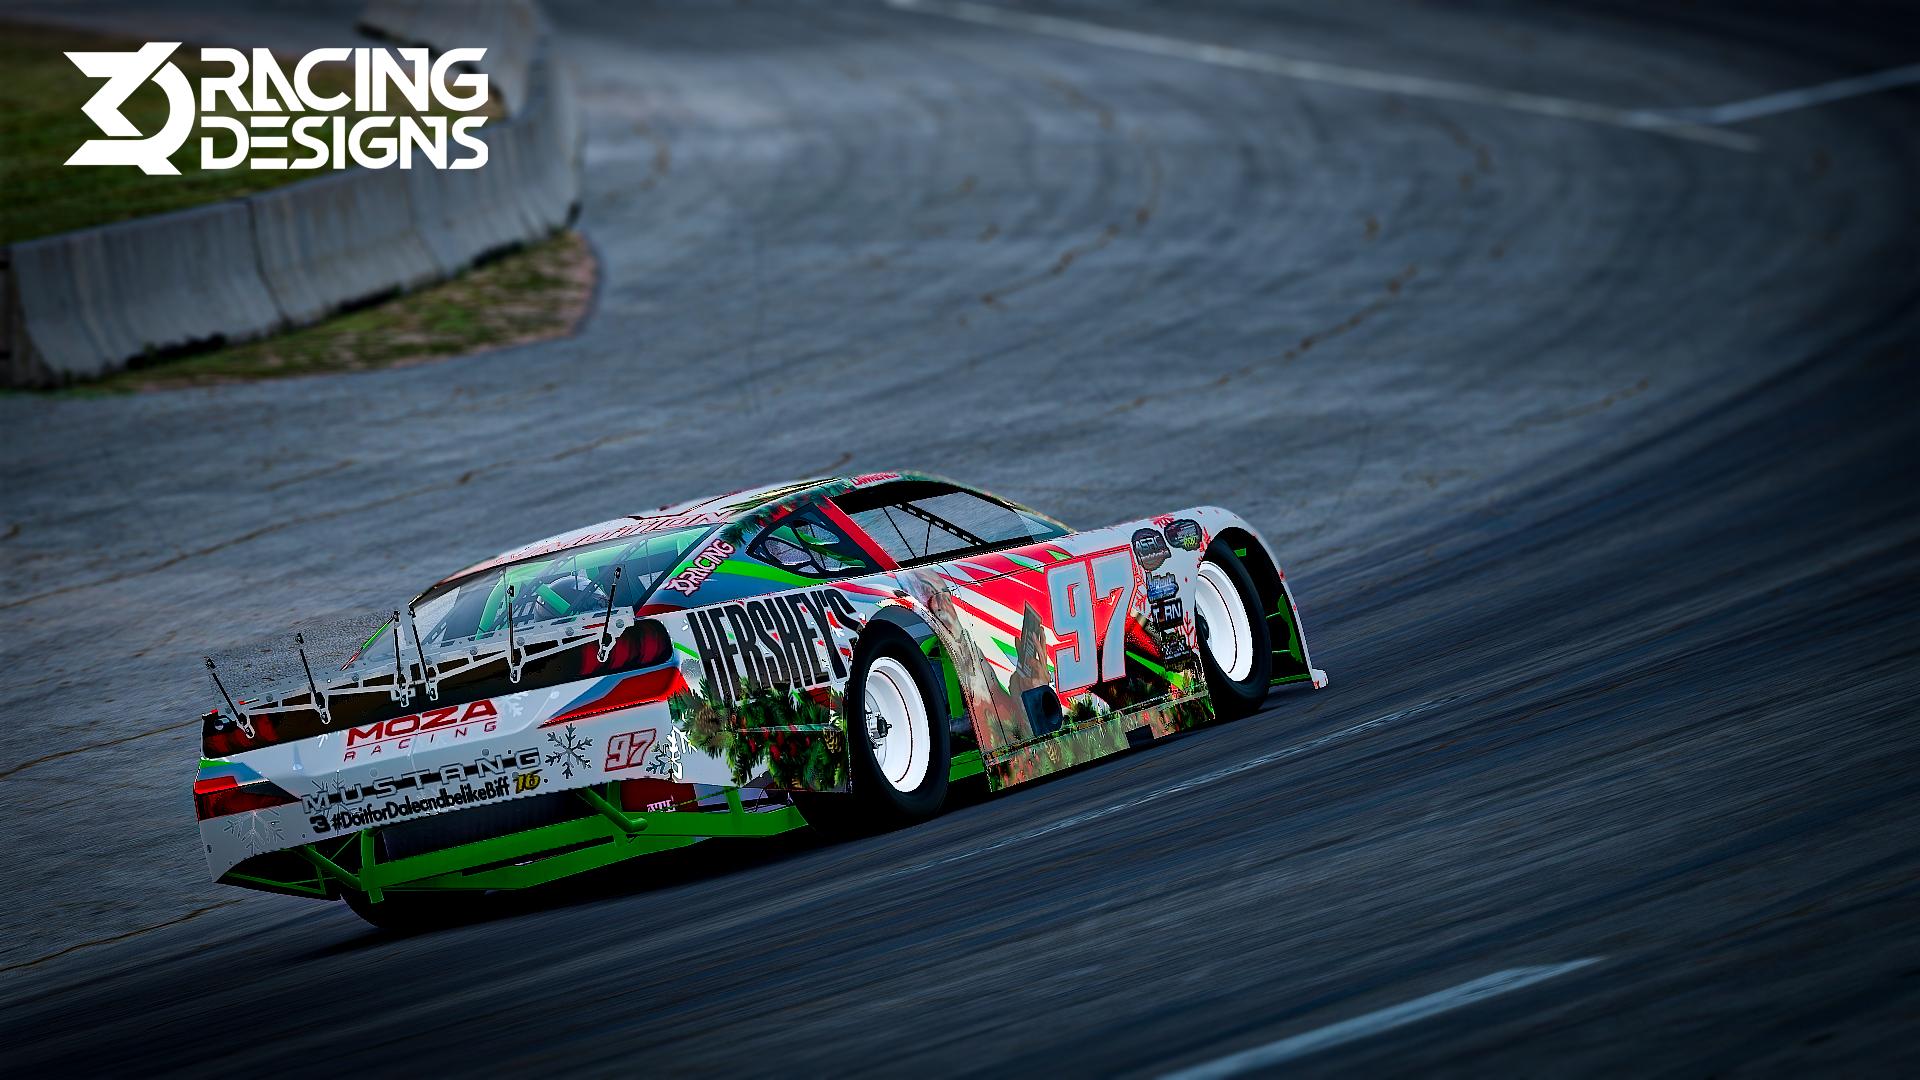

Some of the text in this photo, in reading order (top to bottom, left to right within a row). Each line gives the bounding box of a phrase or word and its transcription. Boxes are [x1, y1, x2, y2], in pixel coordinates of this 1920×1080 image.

[677, 539, 736, 586] RACING
[1045, 543, 1136, 698] 97
[686, 588, 860, 704] HERSHEY'S
[343, 720, 497, 763] RACING
[346, 699, 498, 747] MOZA
[604, 728, 657, 772] 97
[301, 747, 543, 815] MUSTANG
